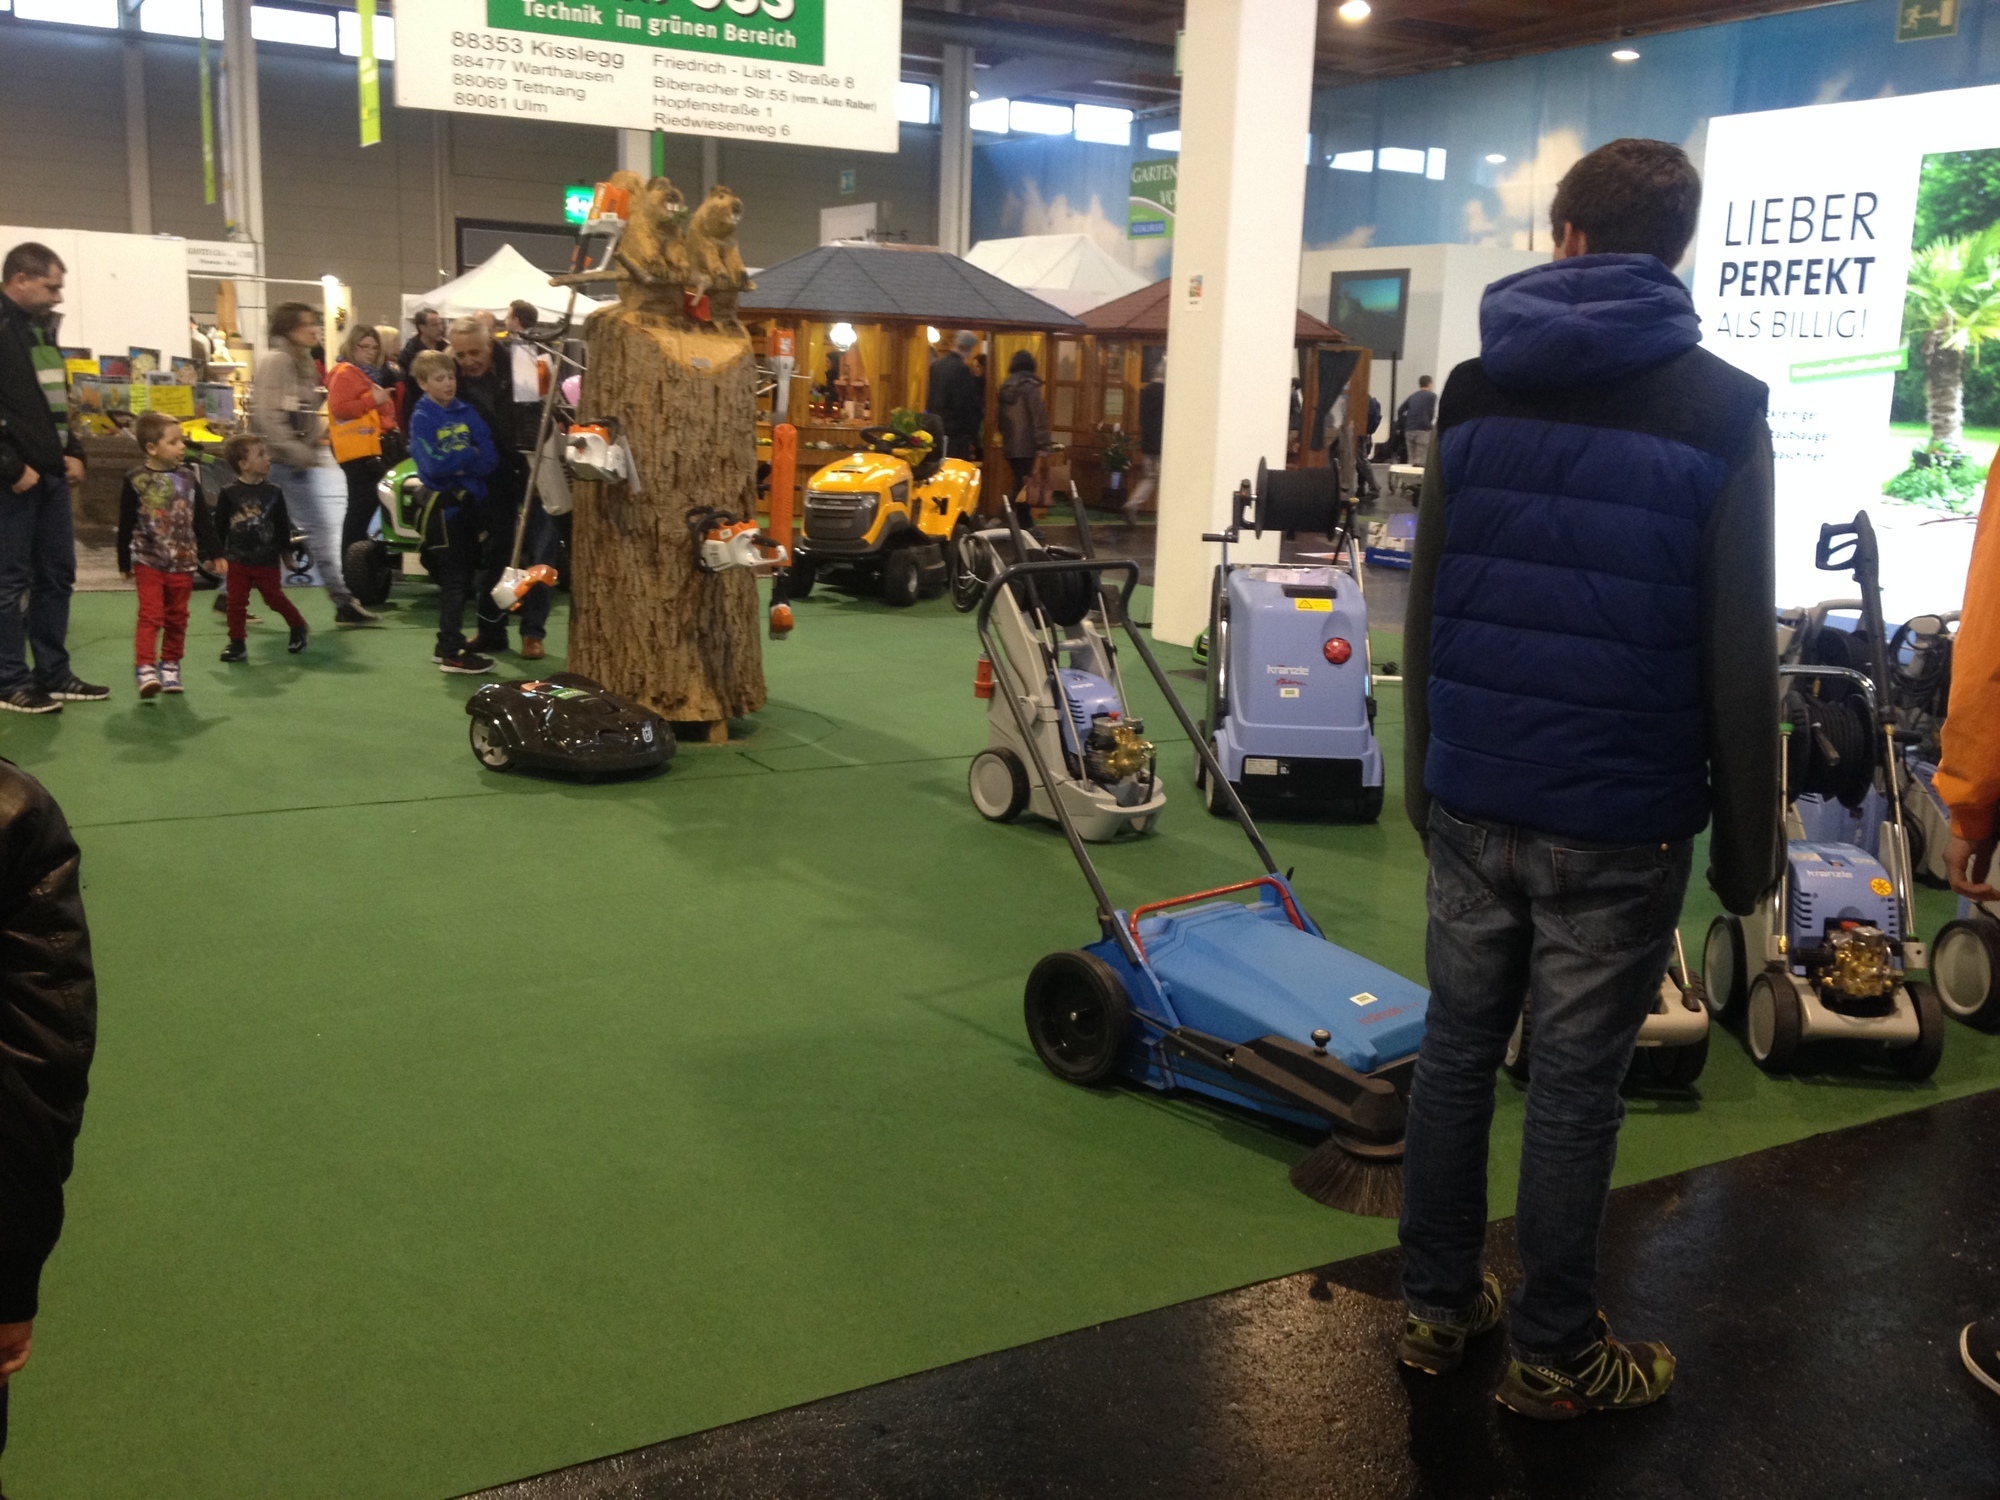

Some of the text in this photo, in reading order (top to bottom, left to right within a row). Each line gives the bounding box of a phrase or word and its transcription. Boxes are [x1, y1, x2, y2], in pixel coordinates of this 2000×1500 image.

[521, 0, 604, 25] Technik
[615, 9, 642, 30] im
[647, 14, 718, 39] grünen
[723, 23, 797, 48] Bereich
[451, 31, 625, 69] 88353 Kisslegg
[451, 54, 615, 83] 88477 Warthausen
[652, 54, 727, 75] Friedrich
[742, 65, 772, 80] List
[787, 70, 841, 88] Straße
[843, 76, 855, 90] 8
[452, 73, 587, 101] 88069 Tettnang
[652, 75, 739, 97] Biberacher
[822, 97, 844, 108] Auto
[453, 92, 549, 113] 89081 Ulm
[652, 95, 773, 118] Hopfenstraße 1
[652, 112, 791, 138] Riedwiesenweg 6
[1159, 190, 1176, 205] VO
[1725, 191, 1879, 246] LIEBER
[1719, 257, 1876, 297] PERFEKT
[1716, 309, 1868, 338] ALS BILLIG!
